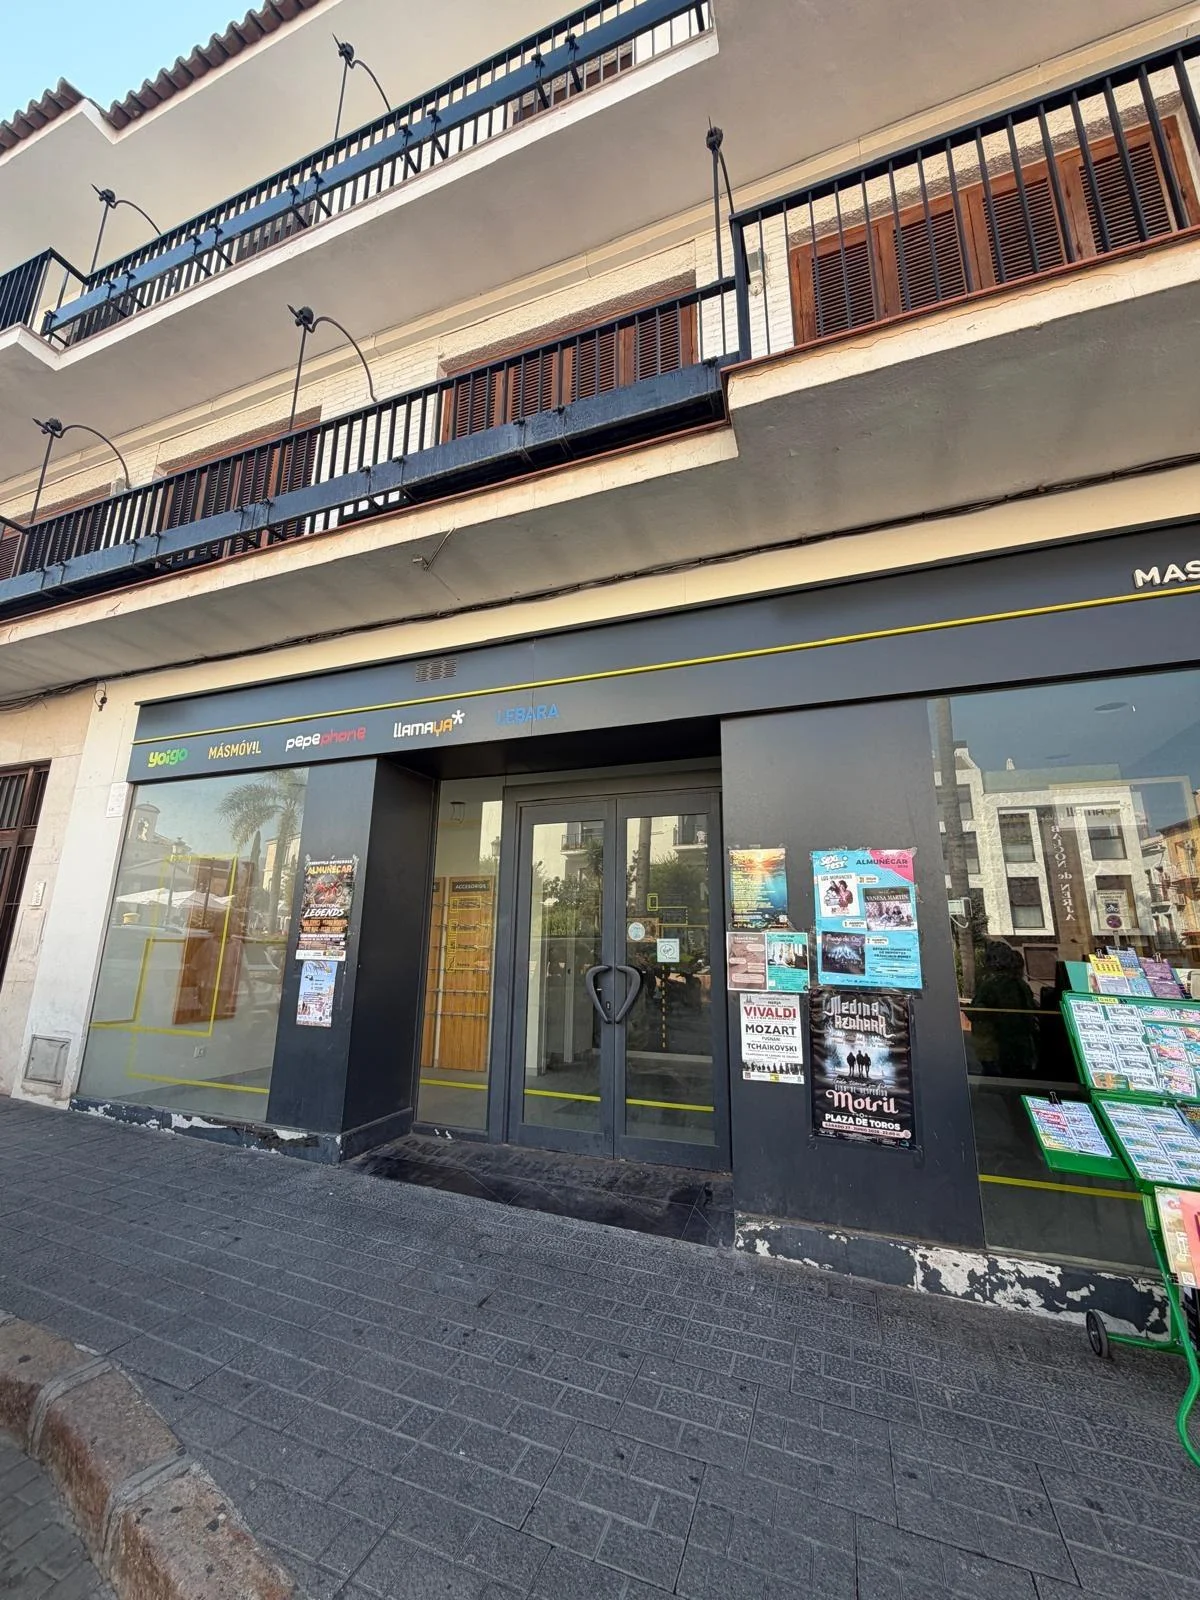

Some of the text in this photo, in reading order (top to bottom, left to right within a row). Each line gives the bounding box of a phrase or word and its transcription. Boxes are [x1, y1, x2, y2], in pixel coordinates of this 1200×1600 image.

[496, 704, 560, 725] LEBARA
[285, 727, 367, 752] pepephone
[147, 748, 189, 768] yoigo
[303, 908, 345, 918] LEGENDS
[743, 1006, 797, 1018] VIVALDI
[745, 1023, 797, 1036] MOZART
[746, 1042, 797, 1052] TCHAIKOVSKI
[825, 1089, 899, 1115] Motril
[825, 1113, 901, 1131] PLAZA DE TOROS
